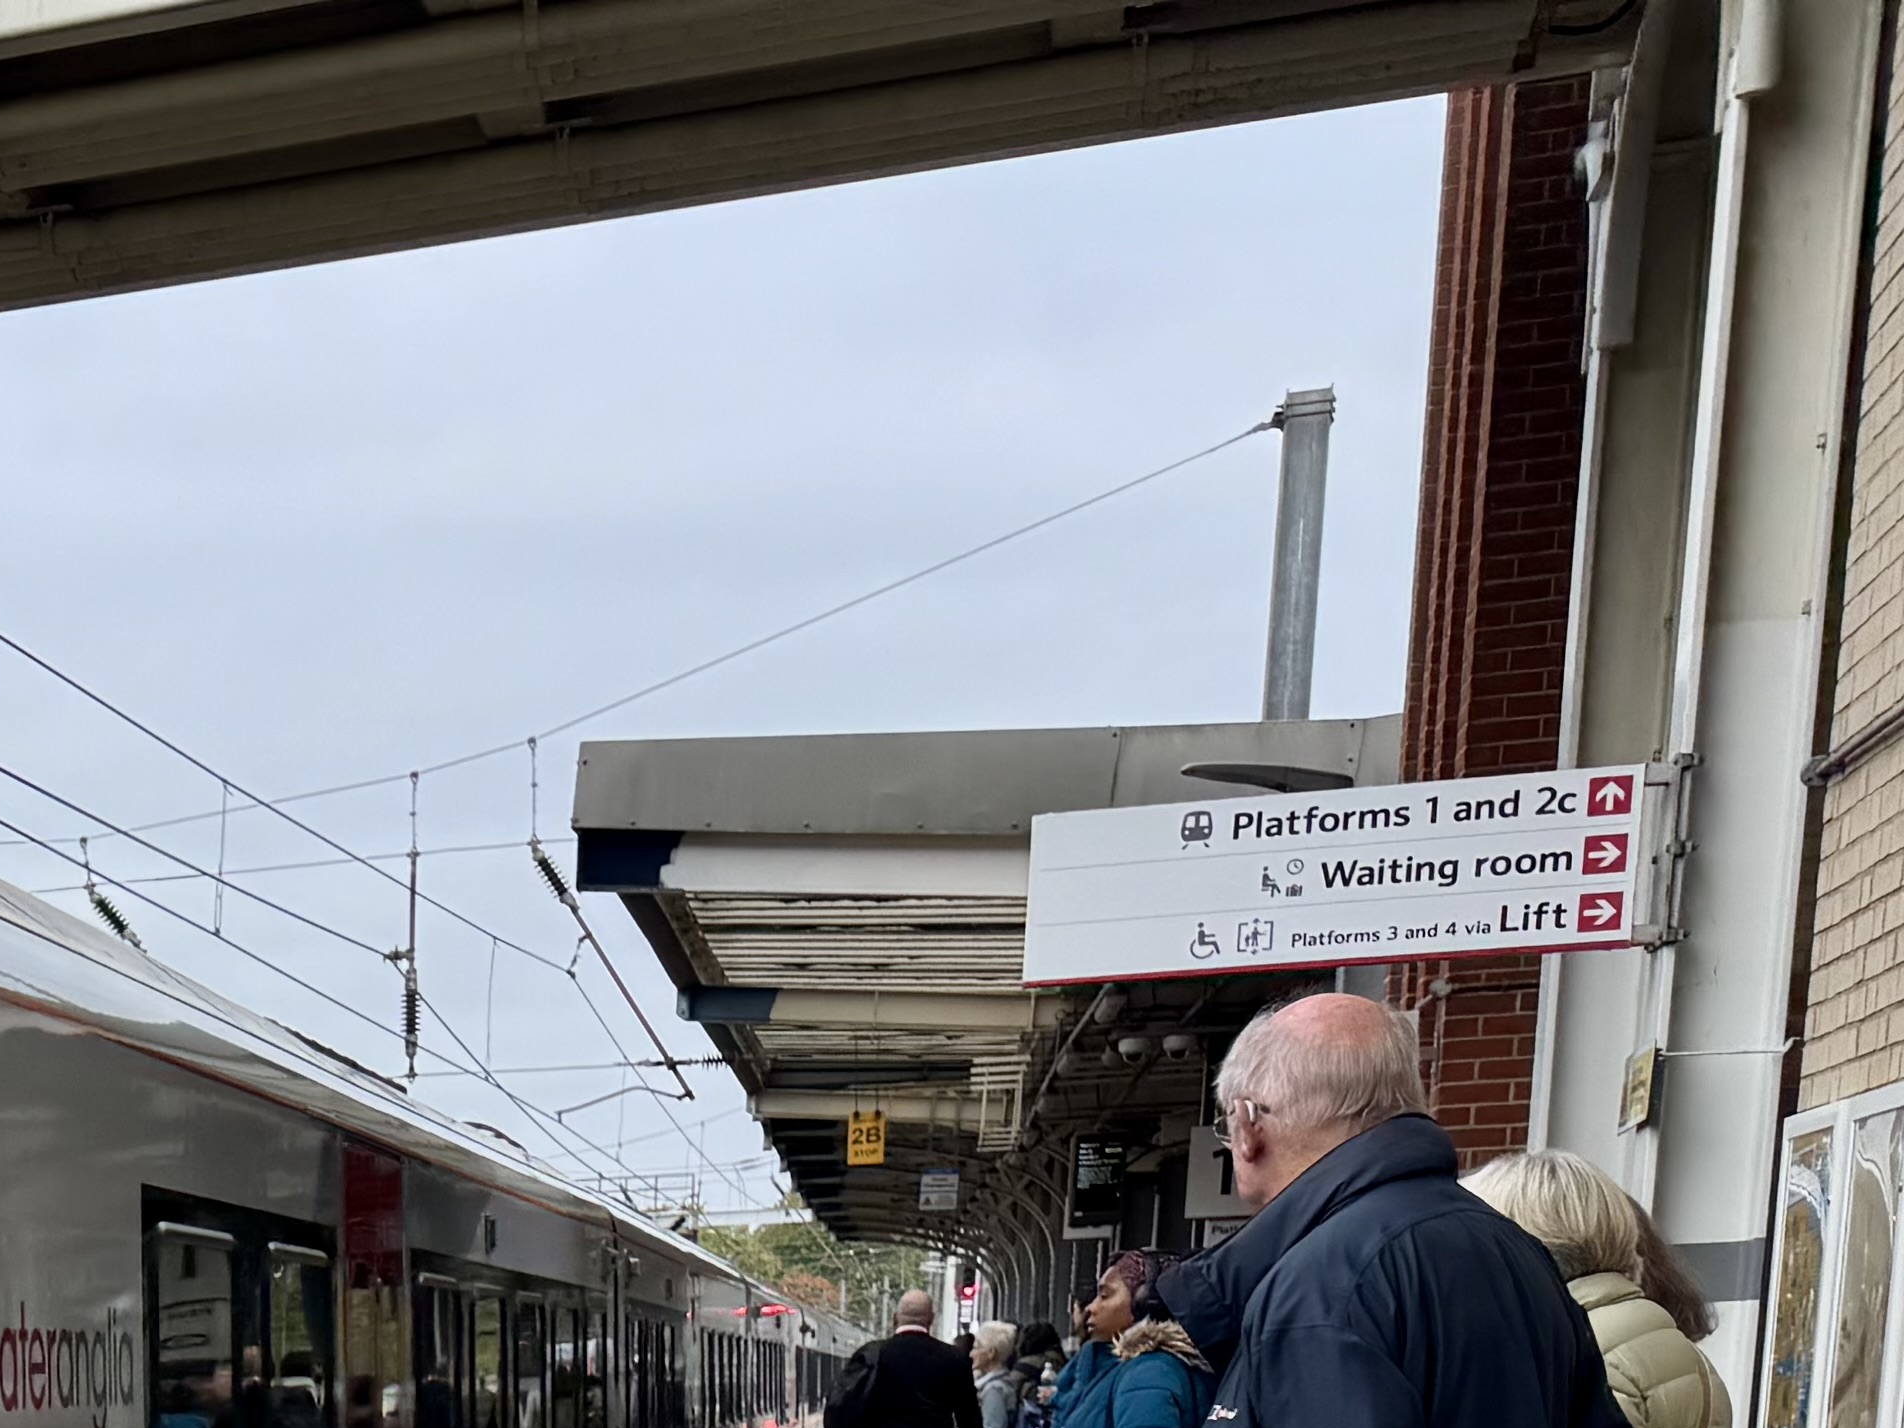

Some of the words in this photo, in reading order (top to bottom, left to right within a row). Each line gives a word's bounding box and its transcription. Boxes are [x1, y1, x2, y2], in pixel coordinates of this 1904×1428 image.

[1232, 805, 1410, 840] Platforms
[1425, 796, 1438, 824] 1
[1453, 789, 1521, 822] and
[1535, 786, 1577, 816] 2c
[1321, 855, 1459, 888] Waiting
[1474, 850, 1573, 878] room
[1291, 929, 1381, 948] Platforms
[1386, 926, 1398, 941] 3
[1405, 923, 1438, 940] and
[1445, 921, 1457, 936] 4
[1465, 920, 1491, 935] via
[1500, 902, 1567, 932] Lift
[852, 1126, 881, 1145] 2B
[1213, 1148, 1234, 1195] 1
